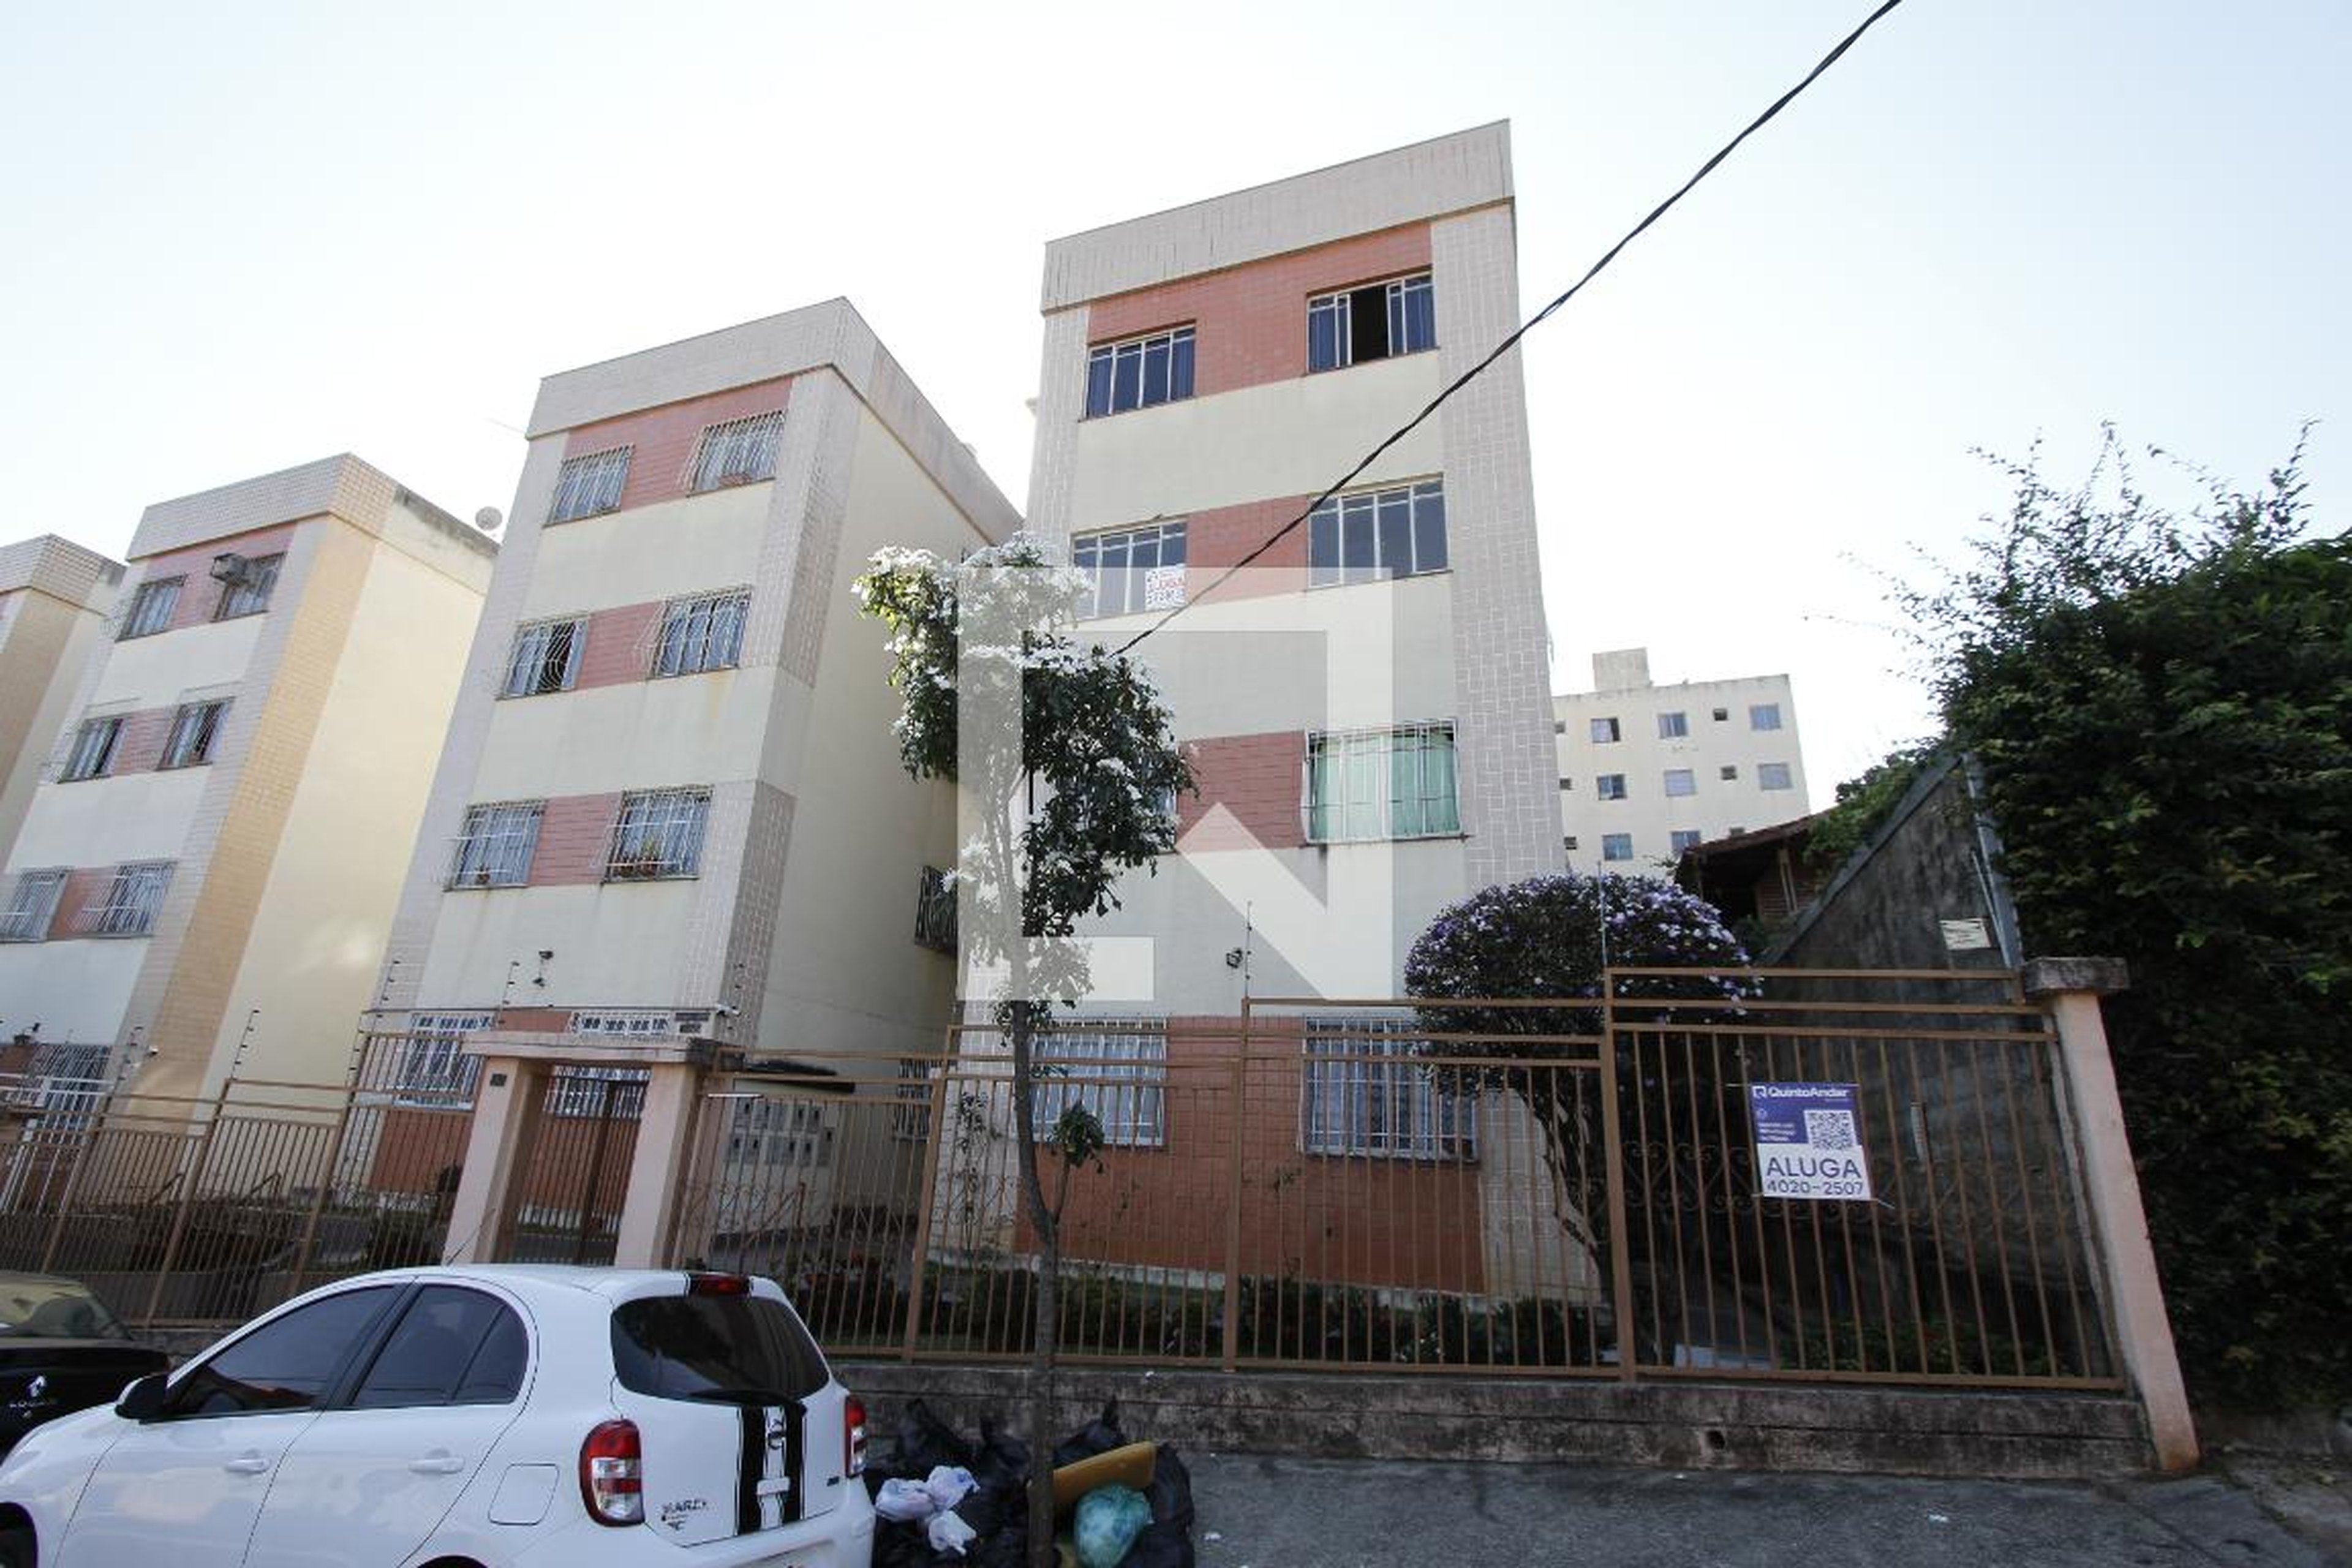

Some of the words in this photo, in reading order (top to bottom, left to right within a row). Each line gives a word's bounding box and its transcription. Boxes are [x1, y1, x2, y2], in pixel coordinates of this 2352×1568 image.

[1768, 1087, 1849, 1097] QuintoAndar
[1766, 1157, 1862, 1178] ALUGA
[1767, 1180, 1863, 1195] 4020-2507
